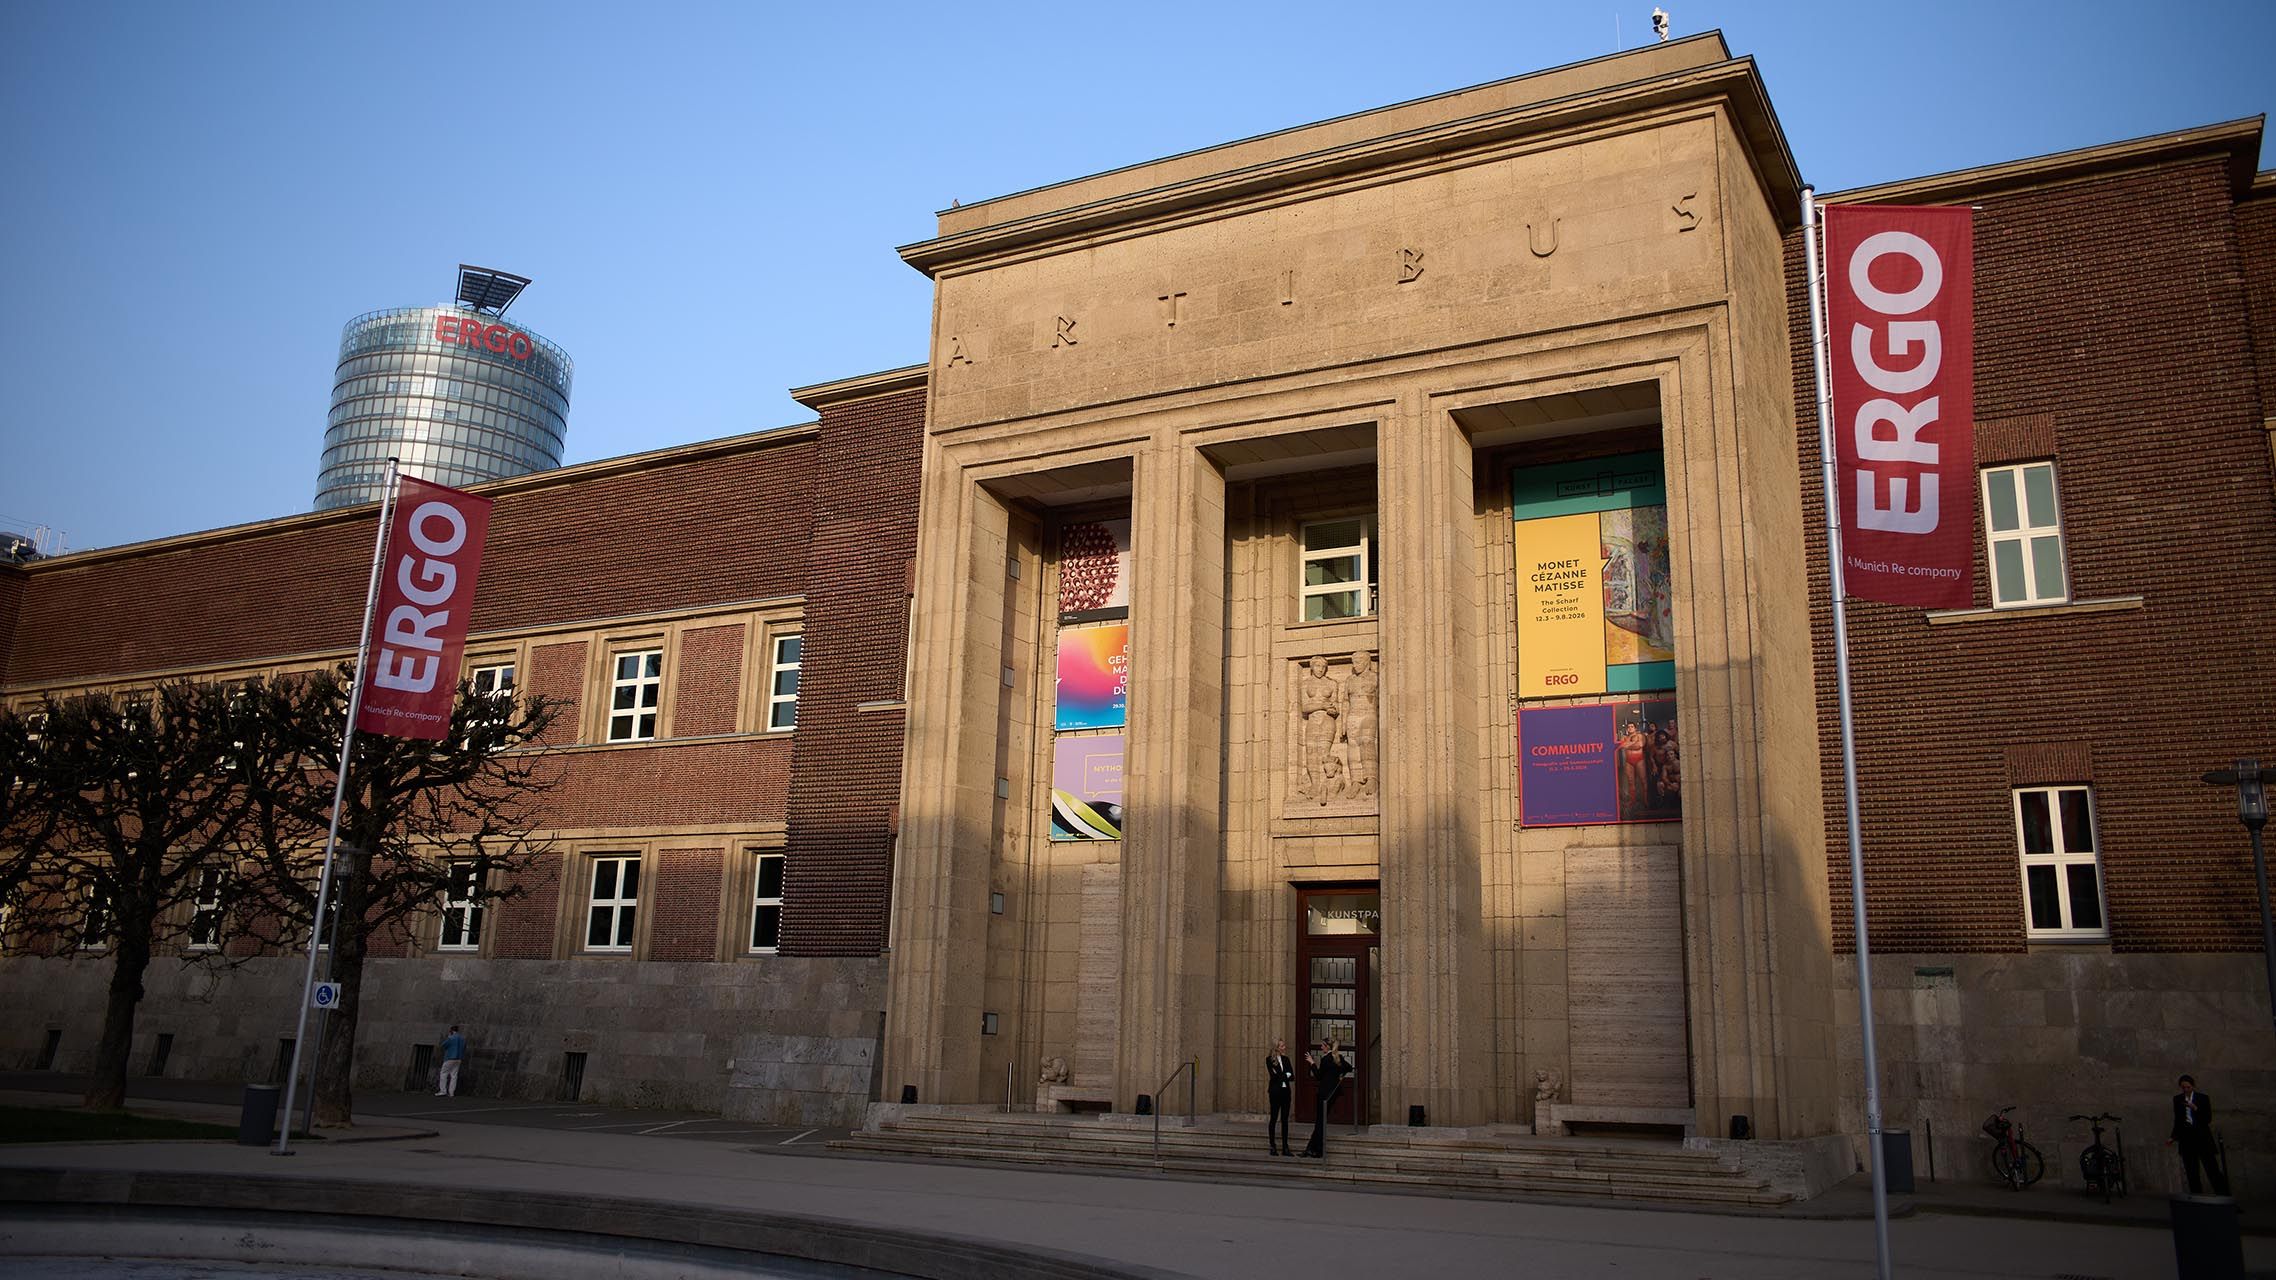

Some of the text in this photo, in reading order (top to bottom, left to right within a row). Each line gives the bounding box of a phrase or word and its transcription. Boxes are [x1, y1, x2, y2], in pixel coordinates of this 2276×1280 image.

[947, 191, 1702, 368] ARTIBUS
[435, 315, 533, 361] ERGO
[1849, 231, 1943, 535] ERGO
[1537, 559, 1580, 571] MONET
[1854, 557, 1889, 573] Munich
[1891, 563, 1905, 574] Re
[1907, 566, 1962, 580] company
[1531, 569, 1587, 582] CÉZANNE
[1534, 580, 1585, 593] MATISSE
[374, 501, 467, 694] ERGO
[1555, 597, 1579, 605] Scharf
[1542, 605, 1578, 614] Collection
[1545, 674, 1579, 685] ERGO
[393, 708, 404, 717] Re
[405, 711, 442, 723] company
[1531, 743, 1603, 756] COMMUNITY
[1327, 910, 1379, 919] KUNSTPA
